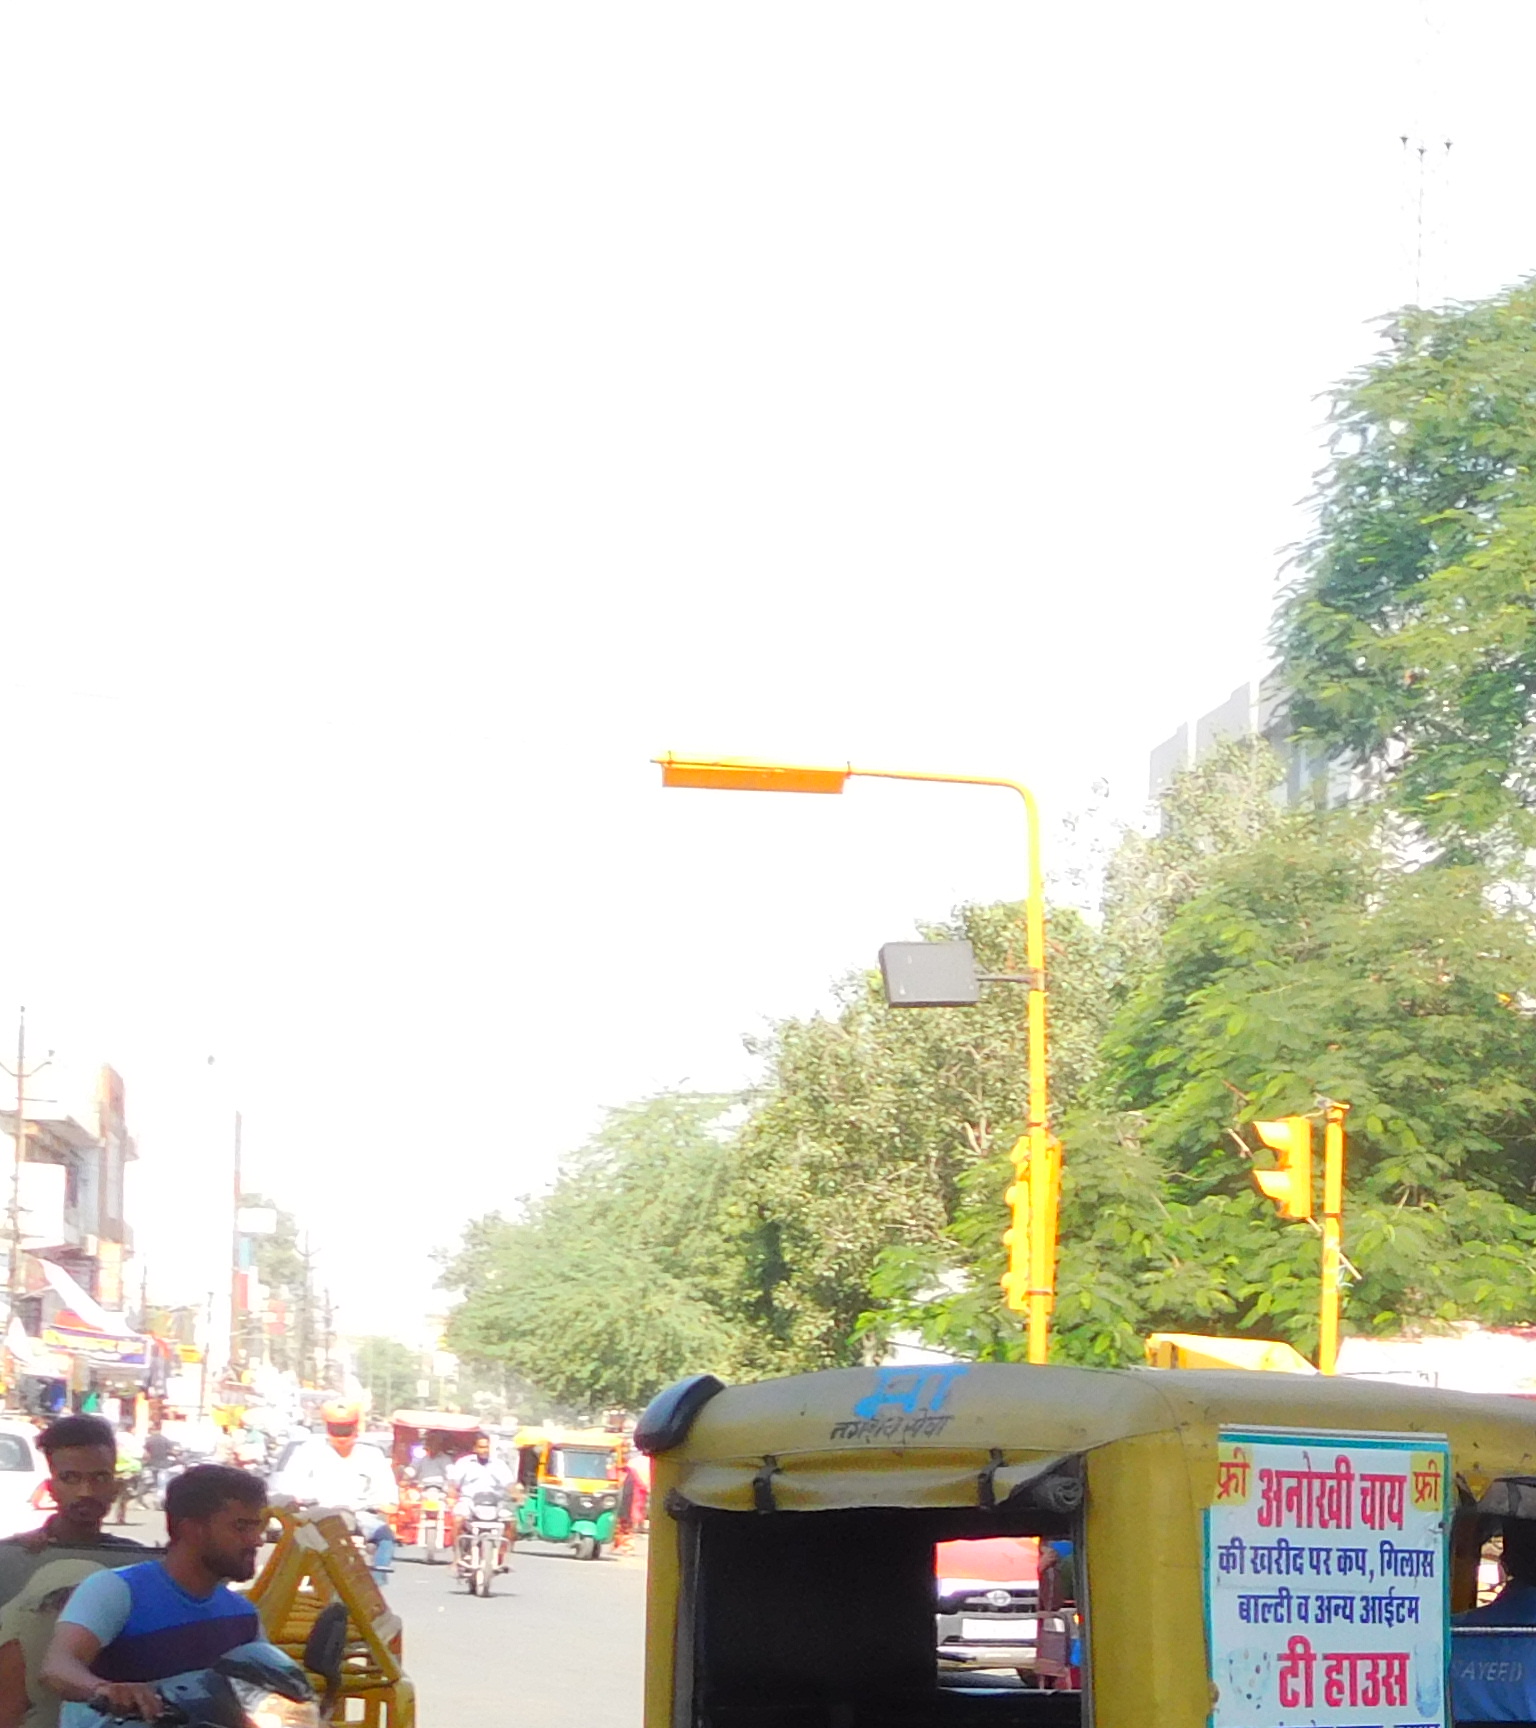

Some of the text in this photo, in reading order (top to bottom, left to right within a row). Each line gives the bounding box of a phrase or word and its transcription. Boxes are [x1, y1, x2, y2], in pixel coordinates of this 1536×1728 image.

[1360, 1473, 1407, 1530] चाय
[1218, 1537, 1247, 1574] की
[1250, 1538, 1304, 1575] खरीद
[1308, 1547, 1332, 1575] पर
[1238, 1586, 1420, 1628] बाल्टी व अन्य आईटम
[1277, 1635, 1410, 1708] टी हाउस
